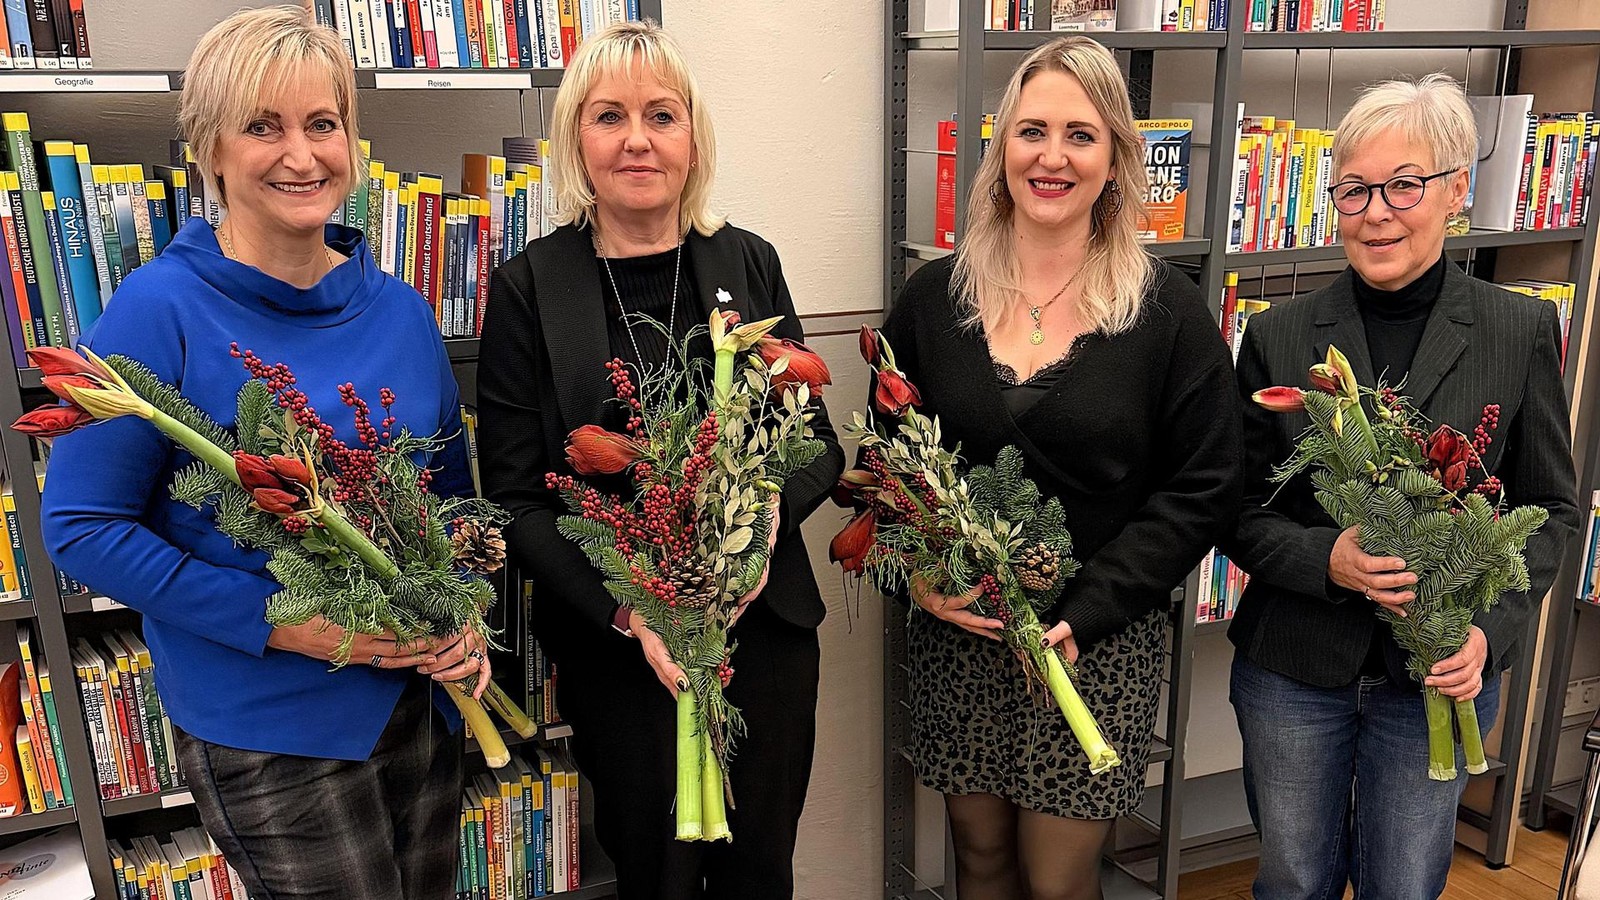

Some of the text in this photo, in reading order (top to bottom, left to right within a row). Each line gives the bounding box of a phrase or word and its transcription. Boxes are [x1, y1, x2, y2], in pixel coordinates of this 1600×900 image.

[445, 7, 450, 17] am
[505, 2, 513, 25] HOW
[55, 78, 94, 87] Geografie
[427, 79, 451, 88] Reisen
[26, 147, 38, 191] DEUTSCHLAND
[1522, 162, 1531, 192] MADEIRA
[1579, 159, 1587, 189] LISSABON
[1235, 170, 1245, 202] Panama
[1537, 168, 1549, 220] ALGARVE
[74, 197, 83, 217] Natur
[517, 194, 525, 216] Küste
[60, 197, 84, 258] HINAUS
[77, 219, 85, 230] die
[423, 197, 434, 250] Deutschland
[5, 219, 21, 272] Rhein-Radweg
[11, 193, 36, 284] DEUTSCHE NORDSEEKÜSTE
[480, 230, 488, 274] Deutschland
[480, 276, 488, 286] für
[8, 515, 21, 548] Russisch
[83, 688, 94, 722] POTSDAM
[126, 689, 133, 698] um
[136, 684, 145, 709] WISMAR
[52, 725, 60, 745] SPANISCH
[91, 688, 113, 782] CityTrip REGENSBURG
[97, 688, 119, 782] CityTrip TRIER
[129, 716, 141, 744] Glücksorte
[123, 735, 132, 761] Weimar
[98, 762, 106, 783] CityTrip
[524, 790, 532, 810] Bayern
